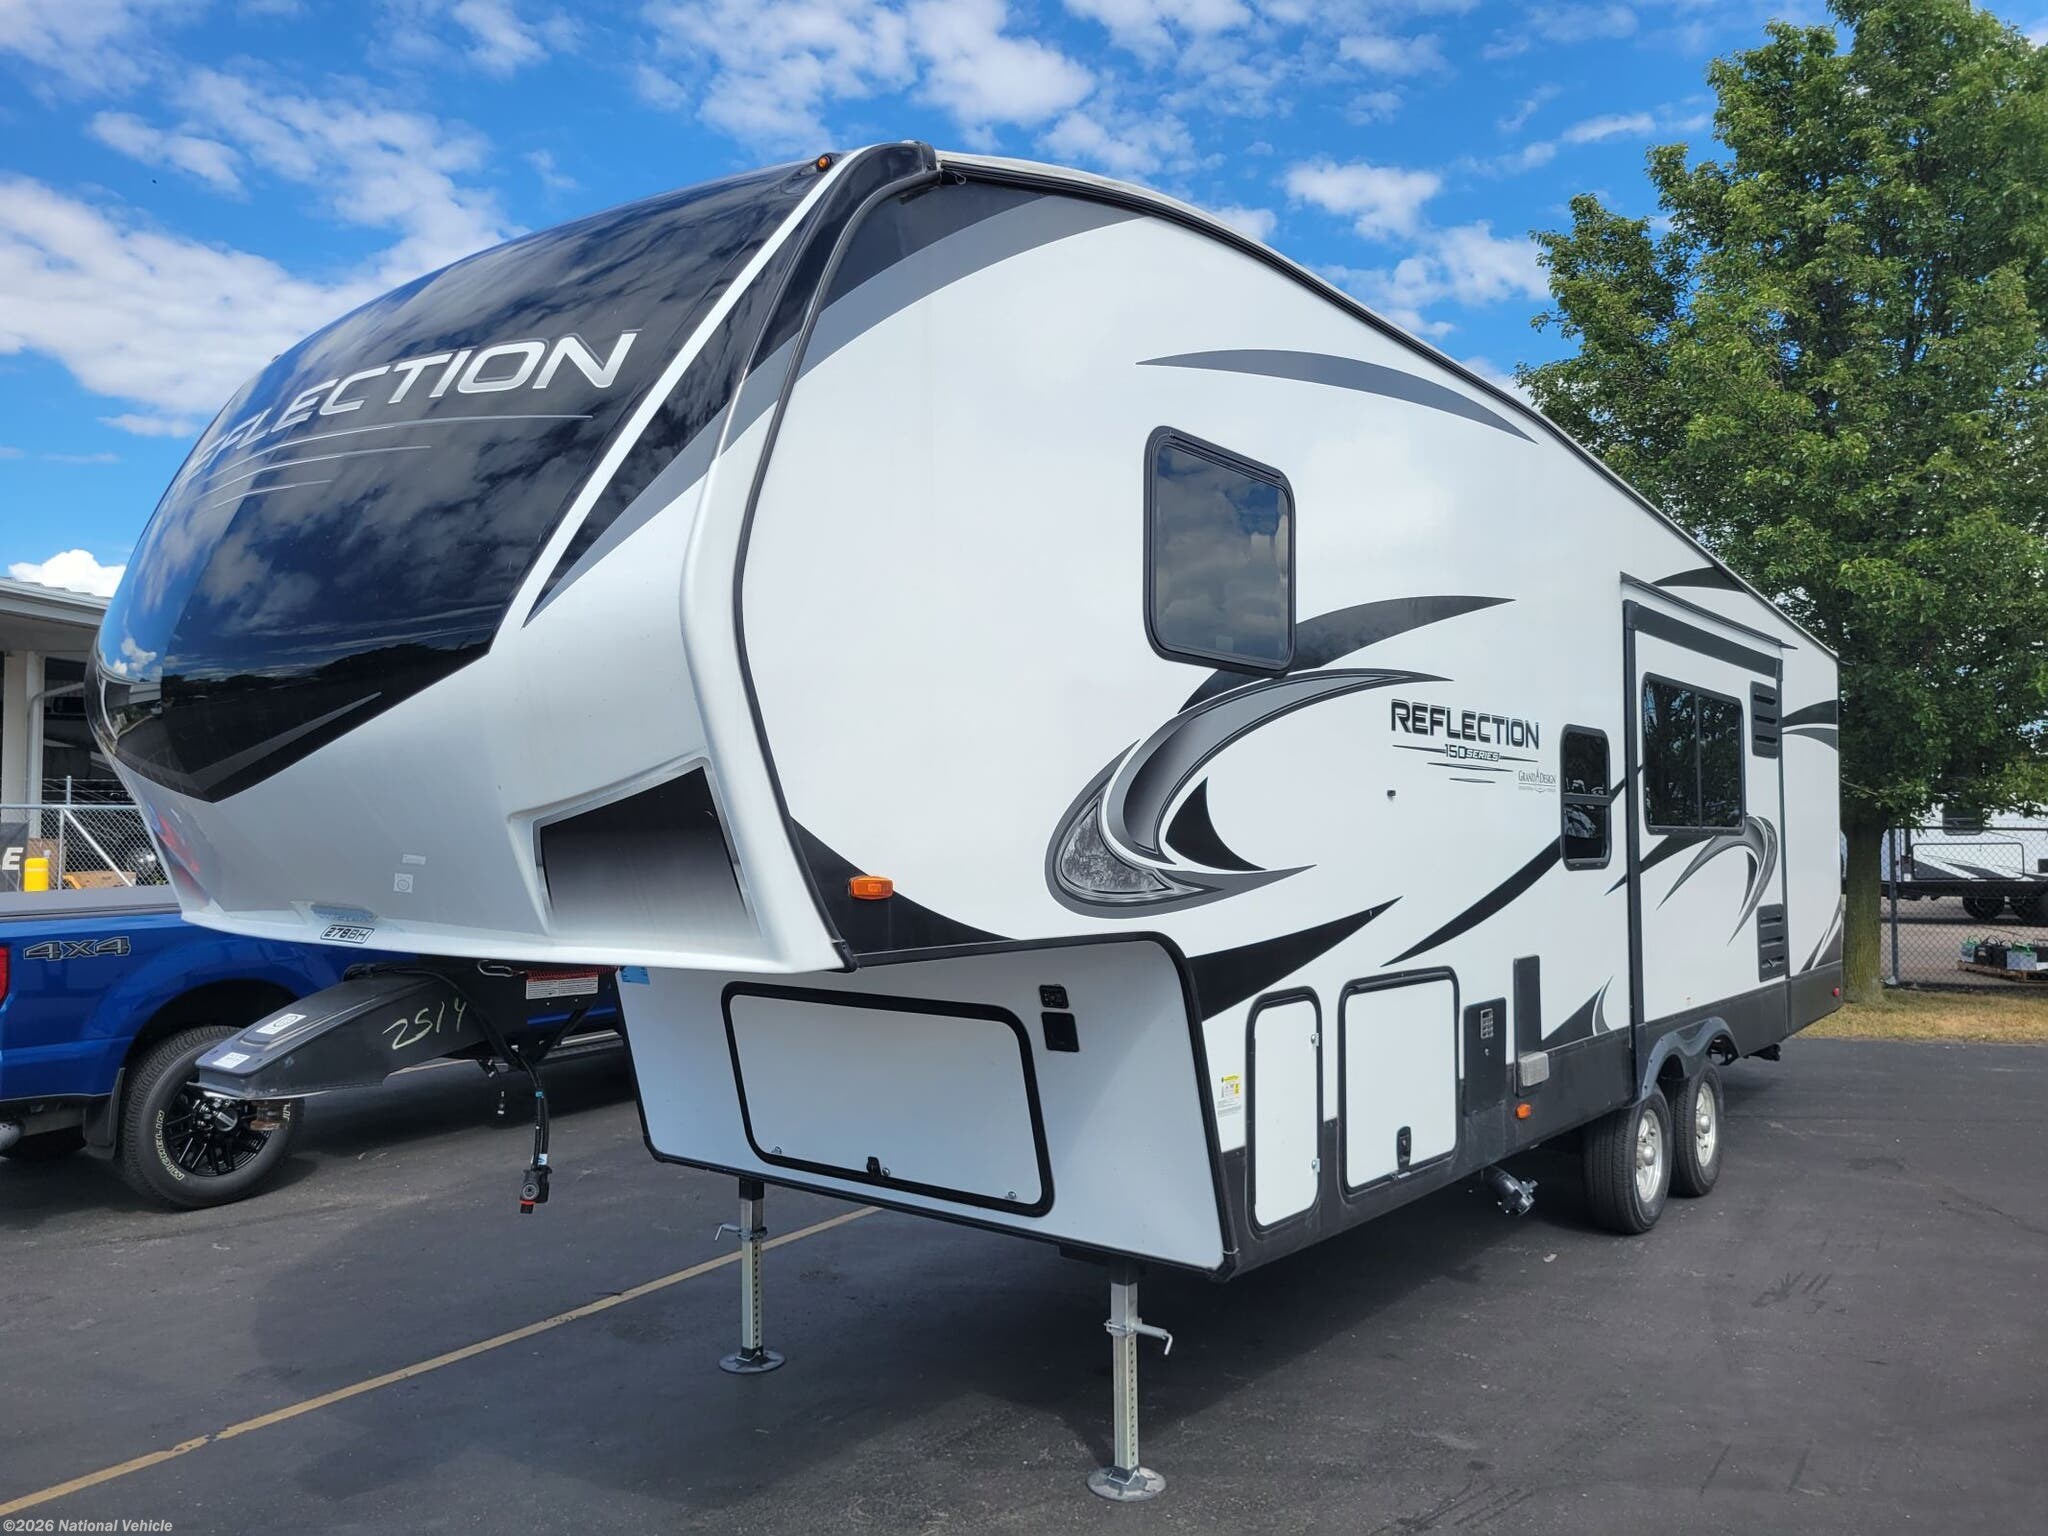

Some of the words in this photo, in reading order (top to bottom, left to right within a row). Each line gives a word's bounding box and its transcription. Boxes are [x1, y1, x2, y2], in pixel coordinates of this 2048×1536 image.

[1391, 698, 1539, 750] REFLECTION
[1445, 743, 1467, 760] 150
[1466, 748, 1500, 762] SERIES
[324, 926, 371, 941] 278BH
[155, 1110, 186, 1181] MICHELIN
